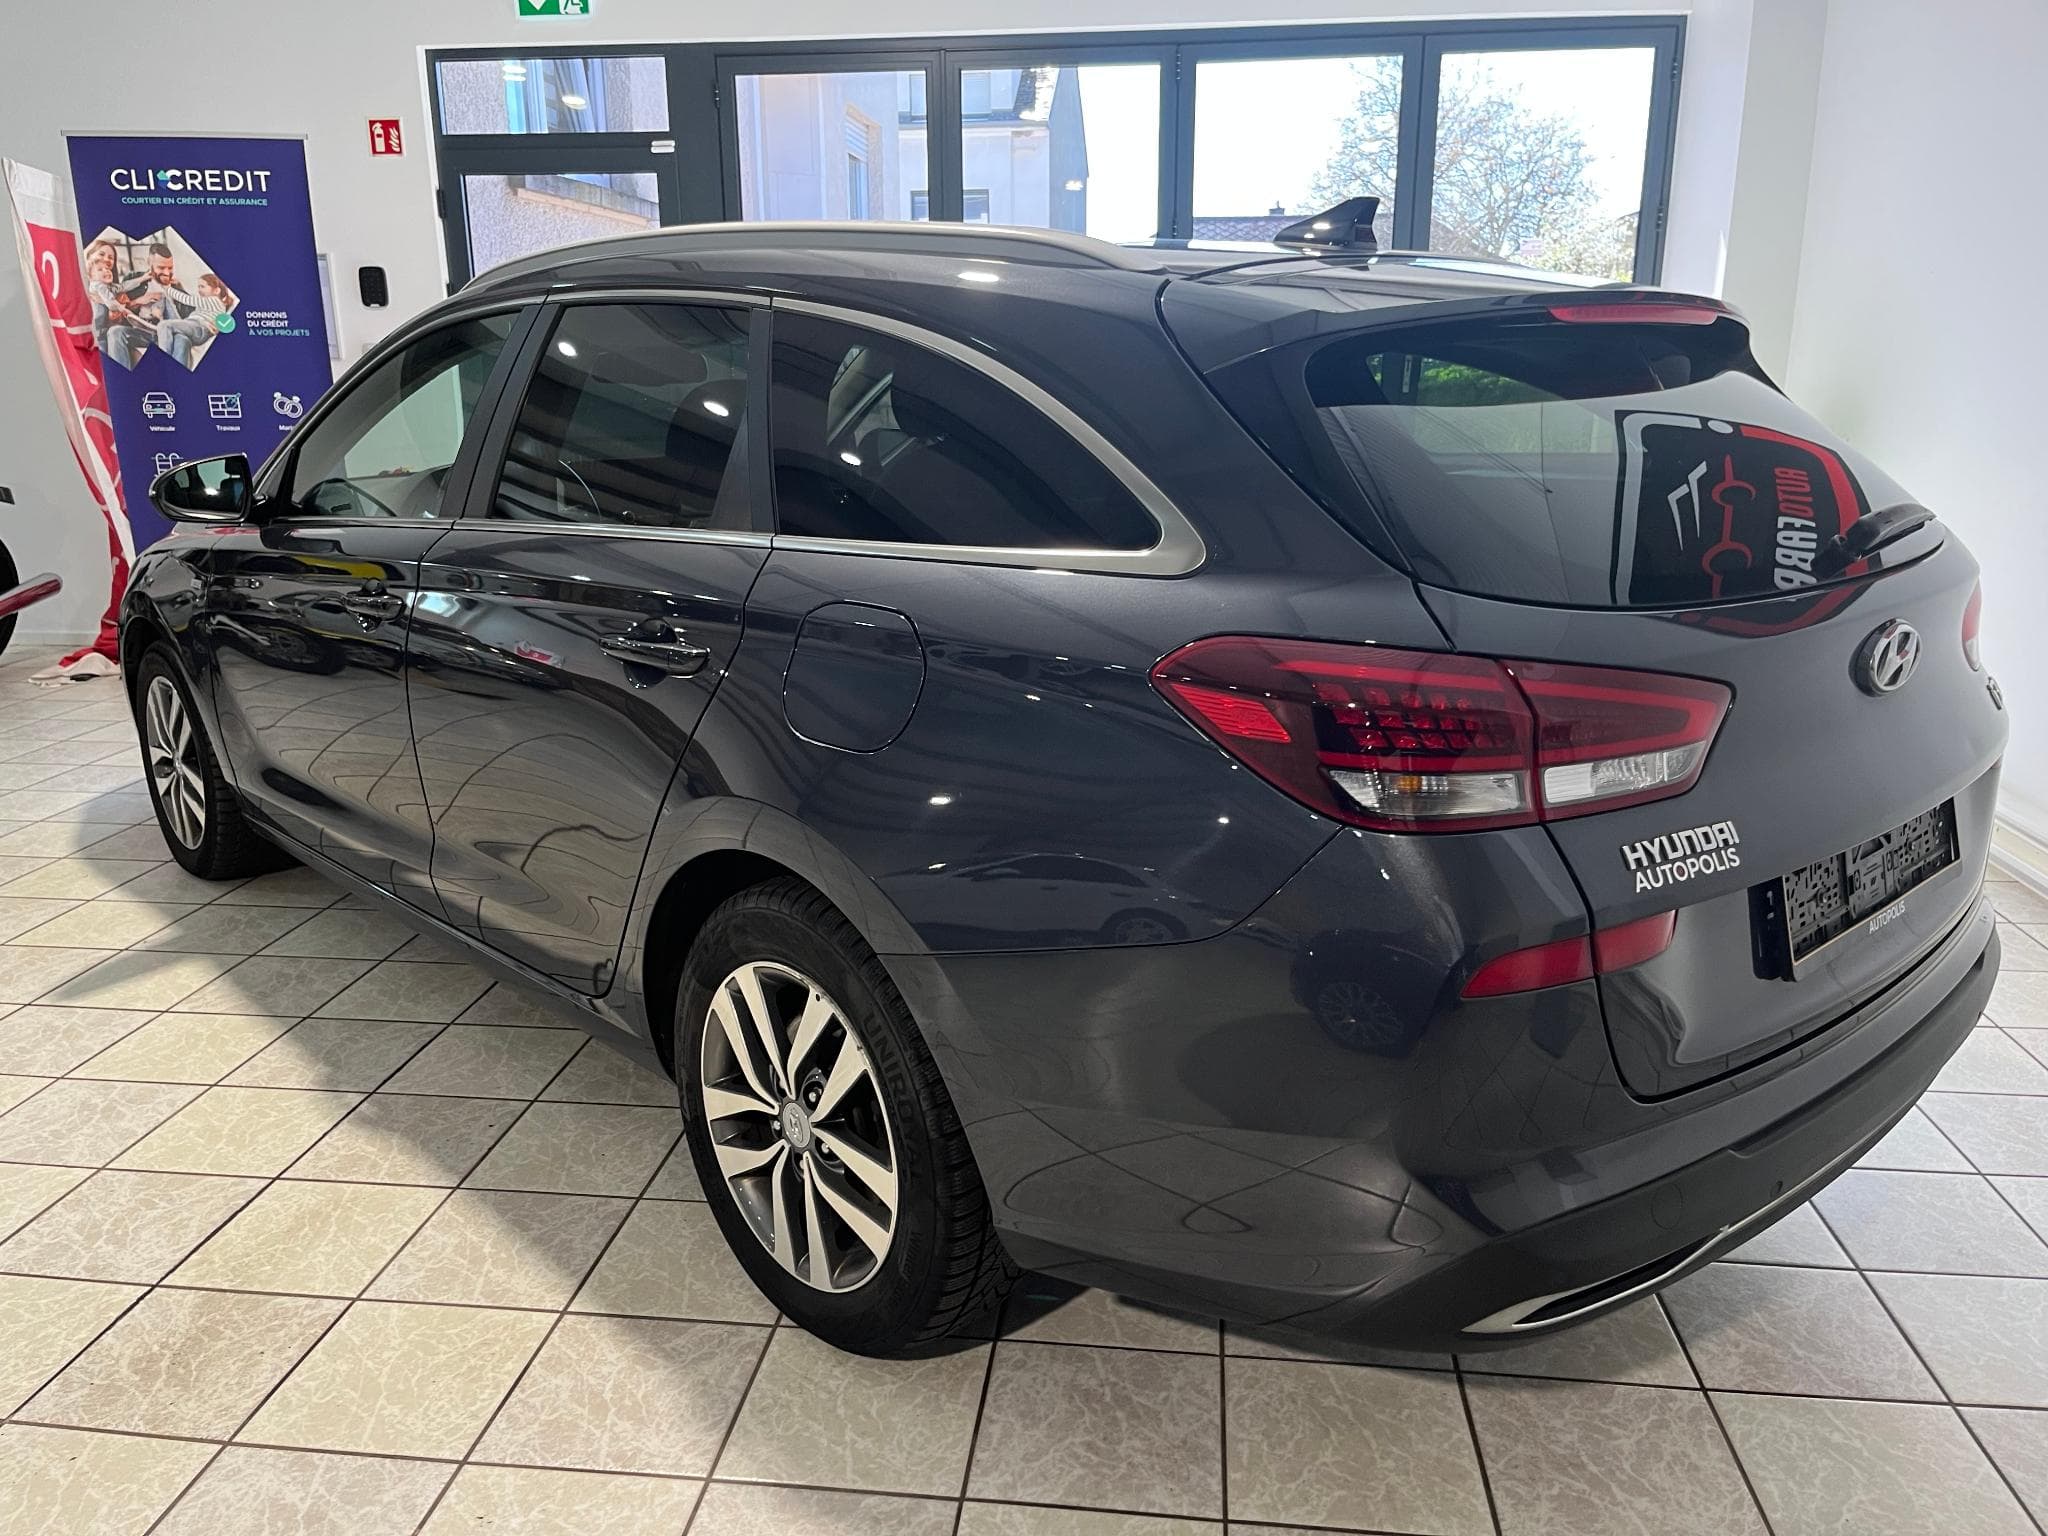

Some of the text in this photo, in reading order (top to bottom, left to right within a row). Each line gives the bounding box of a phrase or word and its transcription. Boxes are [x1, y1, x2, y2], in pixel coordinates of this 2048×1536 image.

[121, 194, 268, 207] COURTIER EN CRÉDIT ET ASSURANCE
[245, 311, 288, 319] DONNONS
[247, 320, 260, 328] DU
[256, 328, 274, 336] VOS
[274, 328, 310, 337] PROJETS
[215, 424, 241, 432] Travaux
[1622, 821, 1740, 870] HYUNDAI
[1635, 847, 1740, 894] AUTOPOLIS
[1869, 900, 1906, 935] AUTOPOLIS
